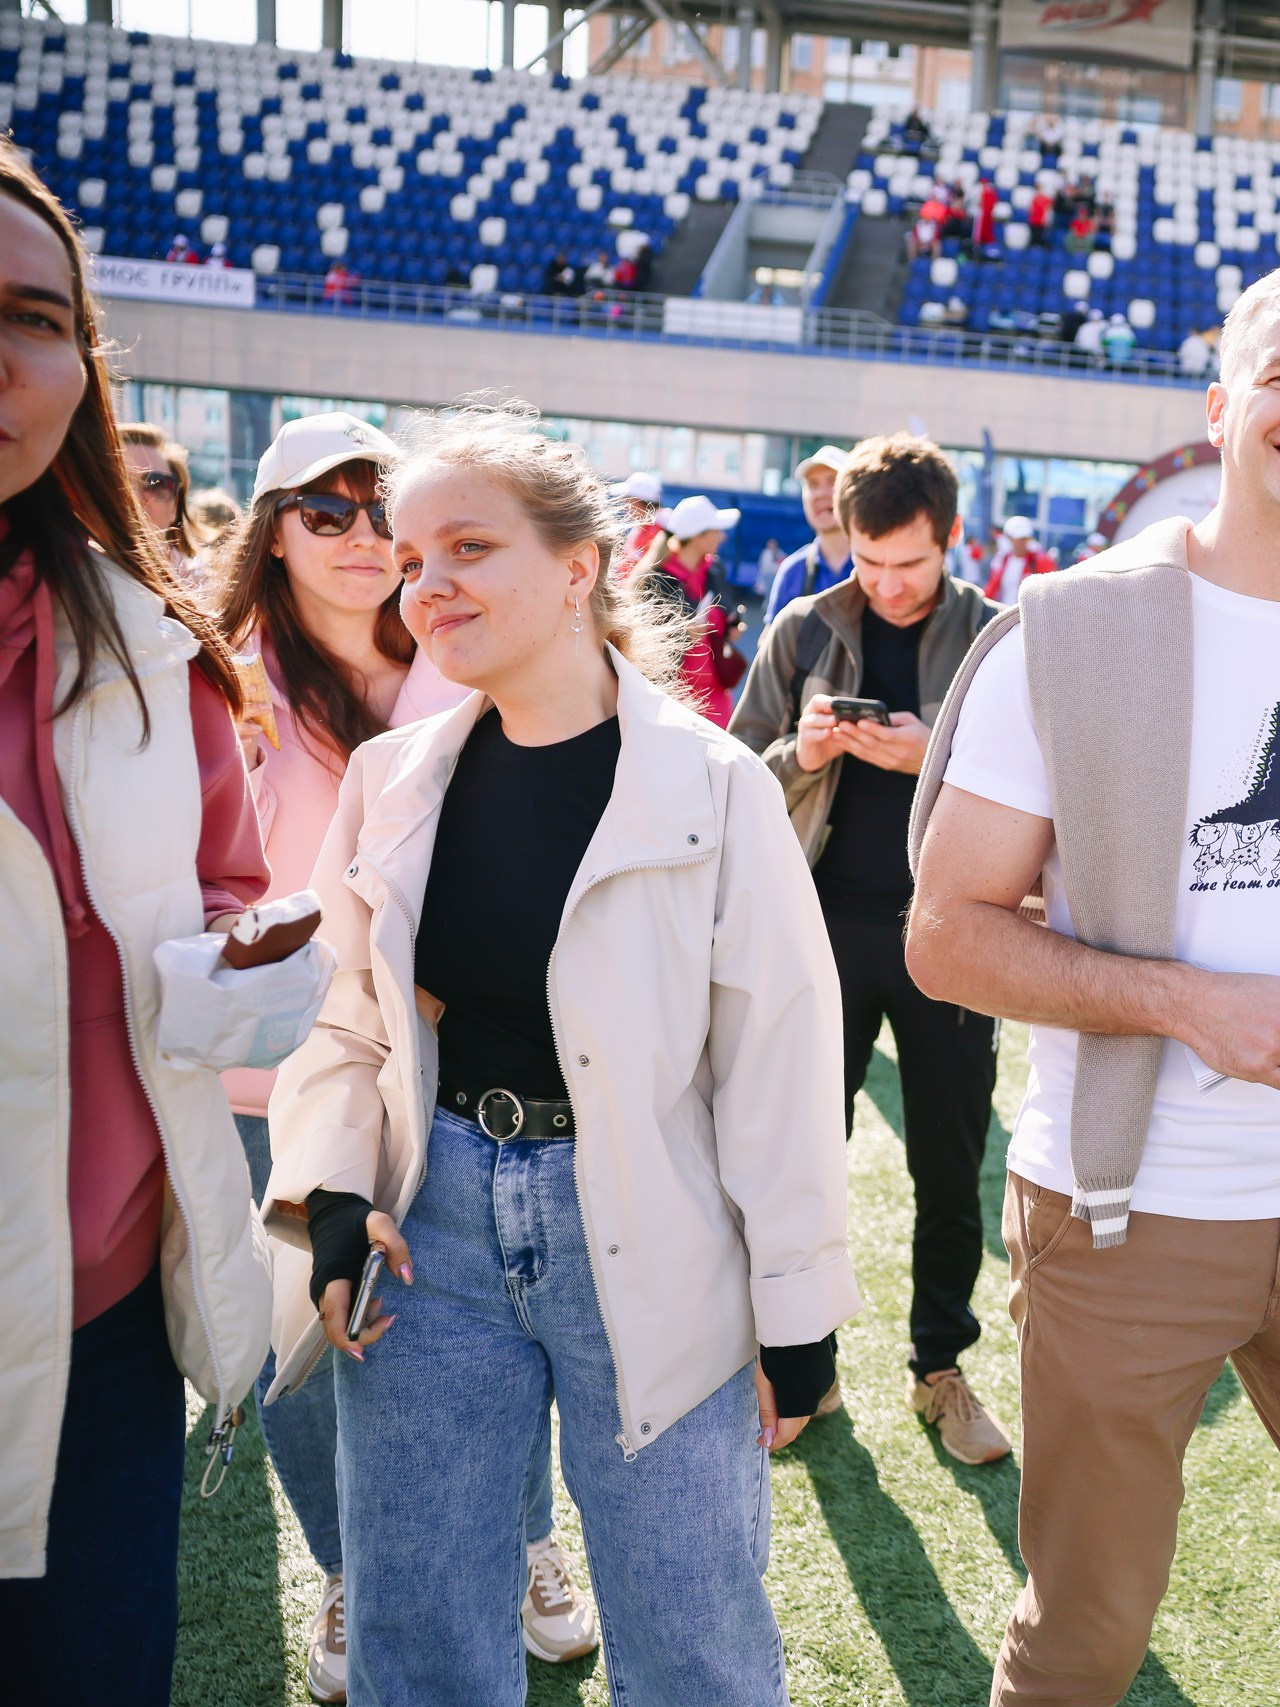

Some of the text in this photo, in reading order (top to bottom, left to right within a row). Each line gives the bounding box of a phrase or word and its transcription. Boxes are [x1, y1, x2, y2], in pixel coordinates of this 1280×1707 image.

[92, 264, 149, 287] МОС
[1242, 707, 1269, 786] personalozaurus
[1189, 881, 1218, 892] one
[1223, 879, 1263, 892] team,
